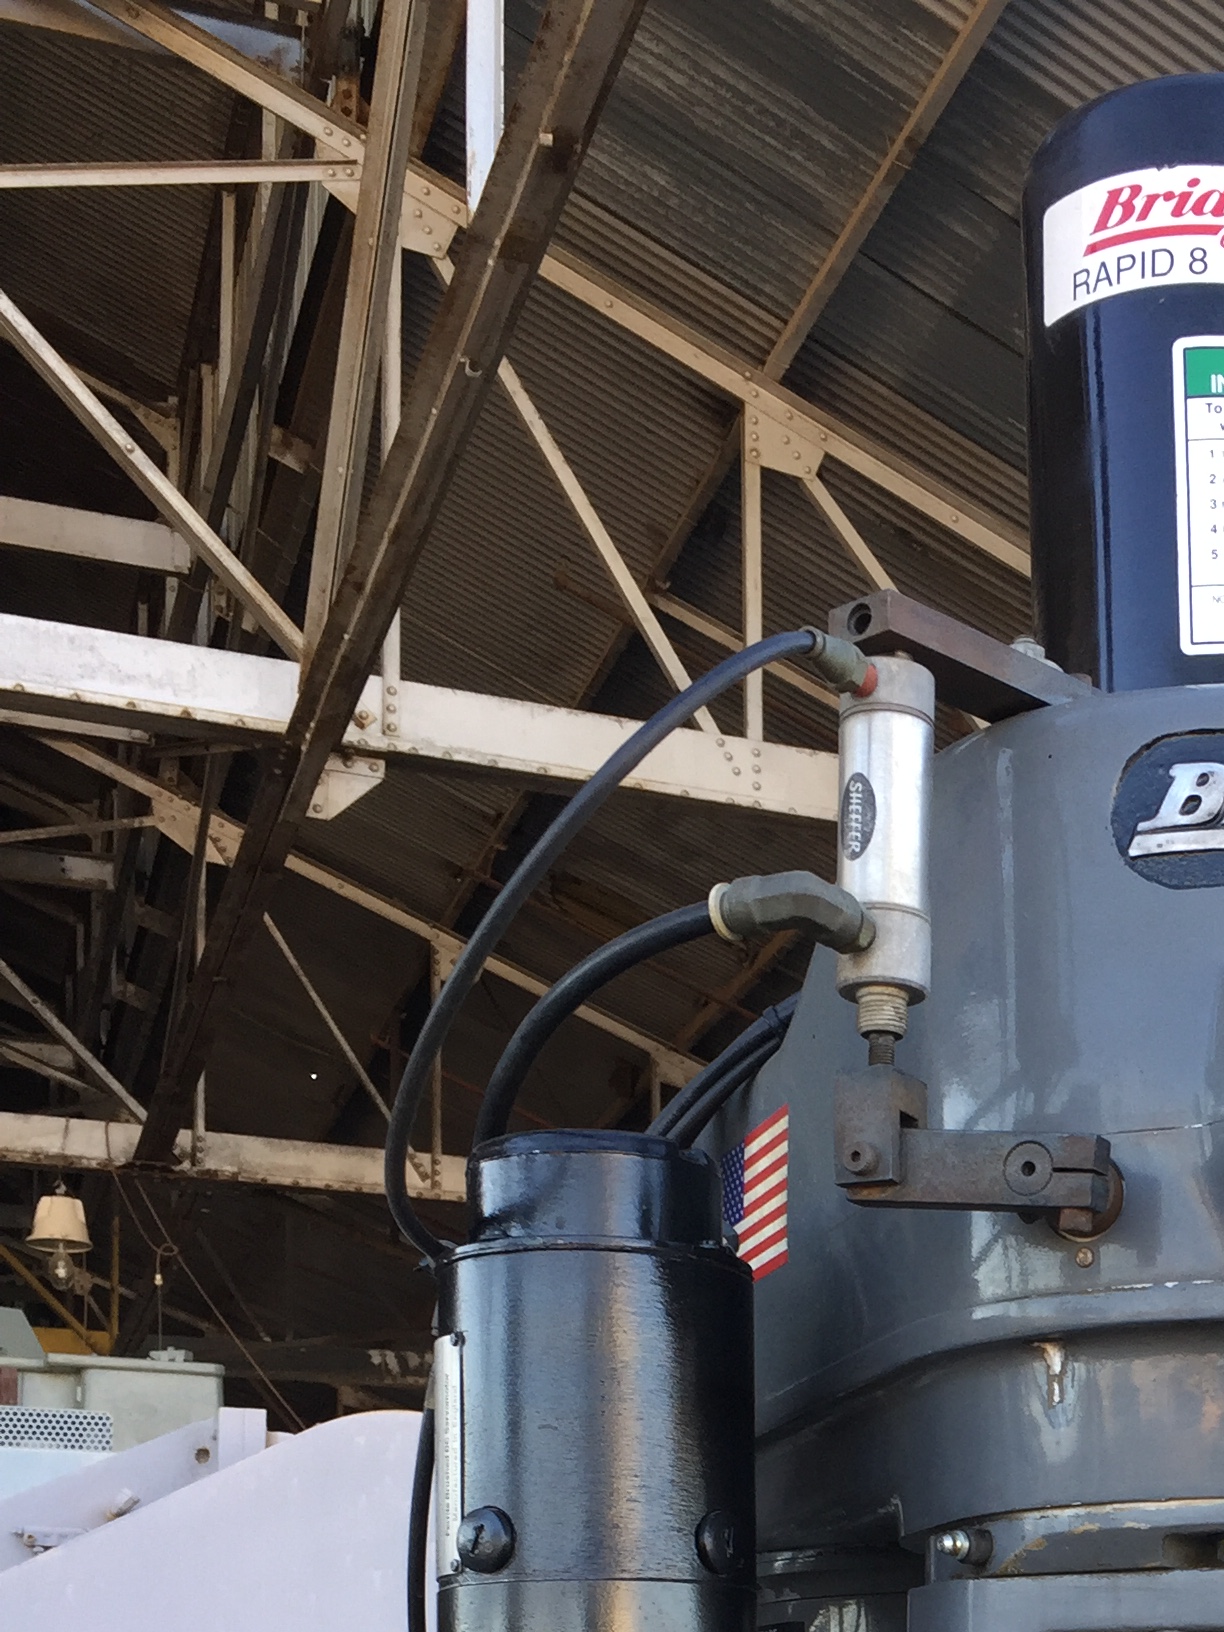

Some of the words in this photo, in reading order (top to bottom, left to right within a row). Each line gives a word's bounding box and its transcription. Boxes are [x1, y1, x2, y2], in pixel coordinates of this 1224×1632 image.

[1073, 248, 1174, 300] RAPID
[1189, 247, 1208, 274] 8
[1205, 403, 1222, 414] To
[1209, 474, 1216, 484] 2
[1210, 500, 1217, 510] 3
[1210, 524, 1217, 534] 4
[1211, 550, 1218, 560] 5
[848, 780, 863, 853] SHEFFER
